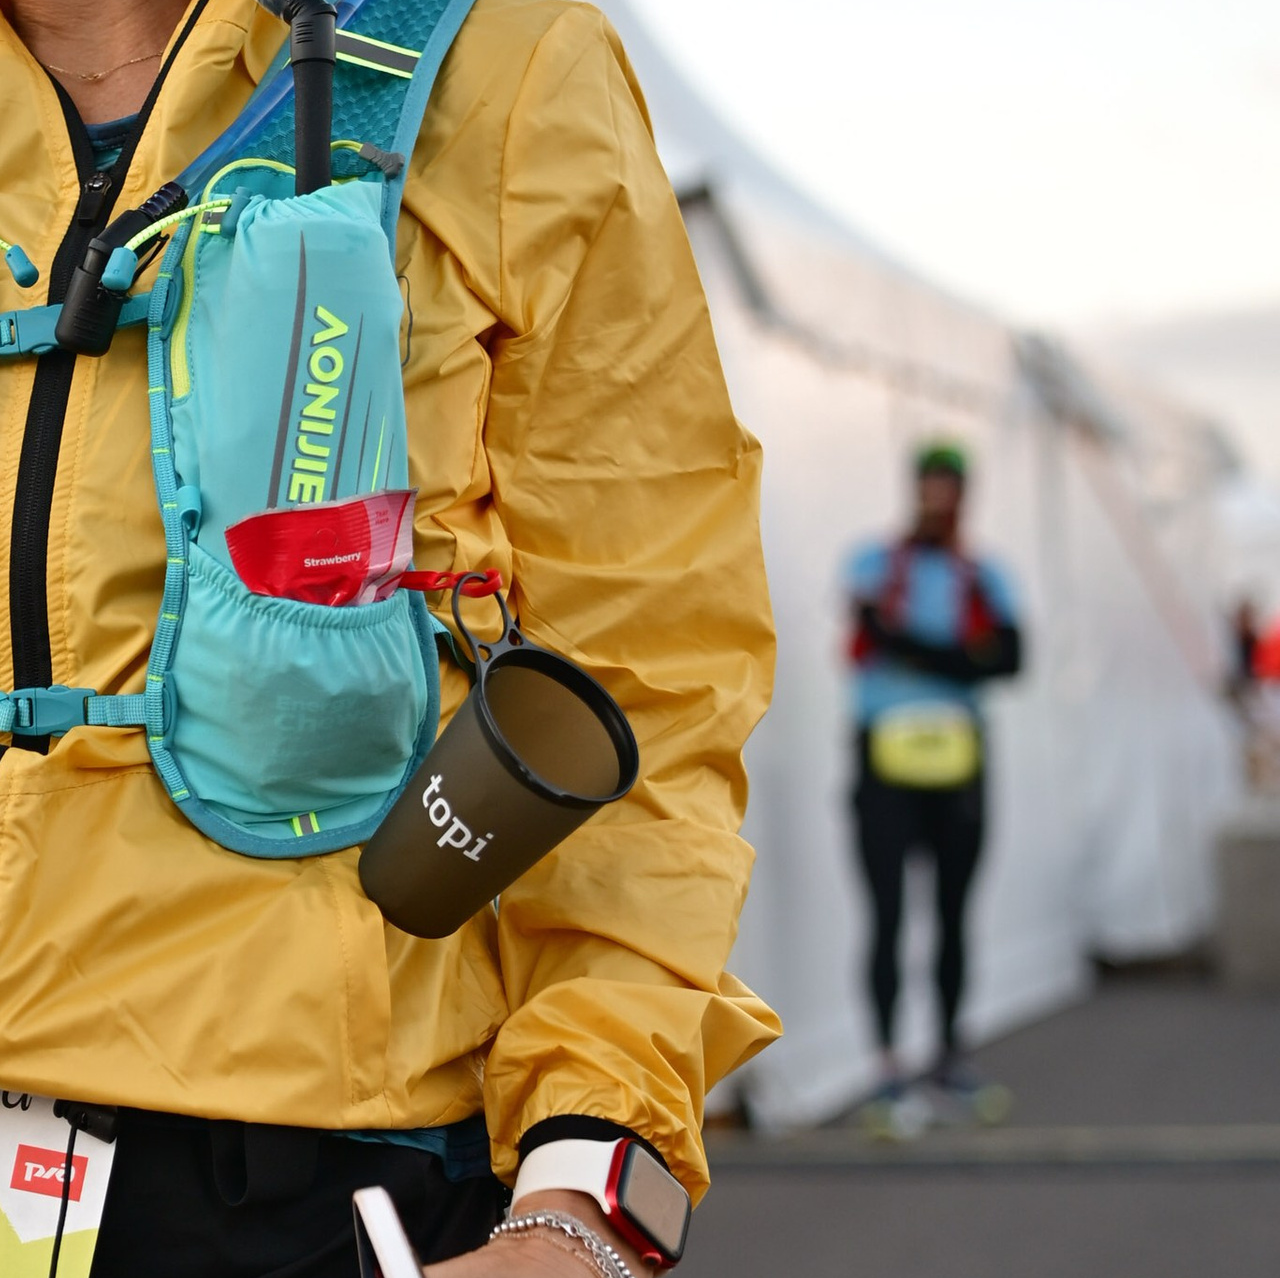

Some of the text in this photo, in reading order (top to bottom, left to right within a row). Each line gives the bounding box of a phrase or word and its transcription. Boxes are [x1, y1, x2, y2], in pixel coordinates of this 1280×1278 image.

[288, 305, 349, 503] AONIJIE
[304, 551, 362, 568] Strawberry
[421, 773, 495, 862] topi
